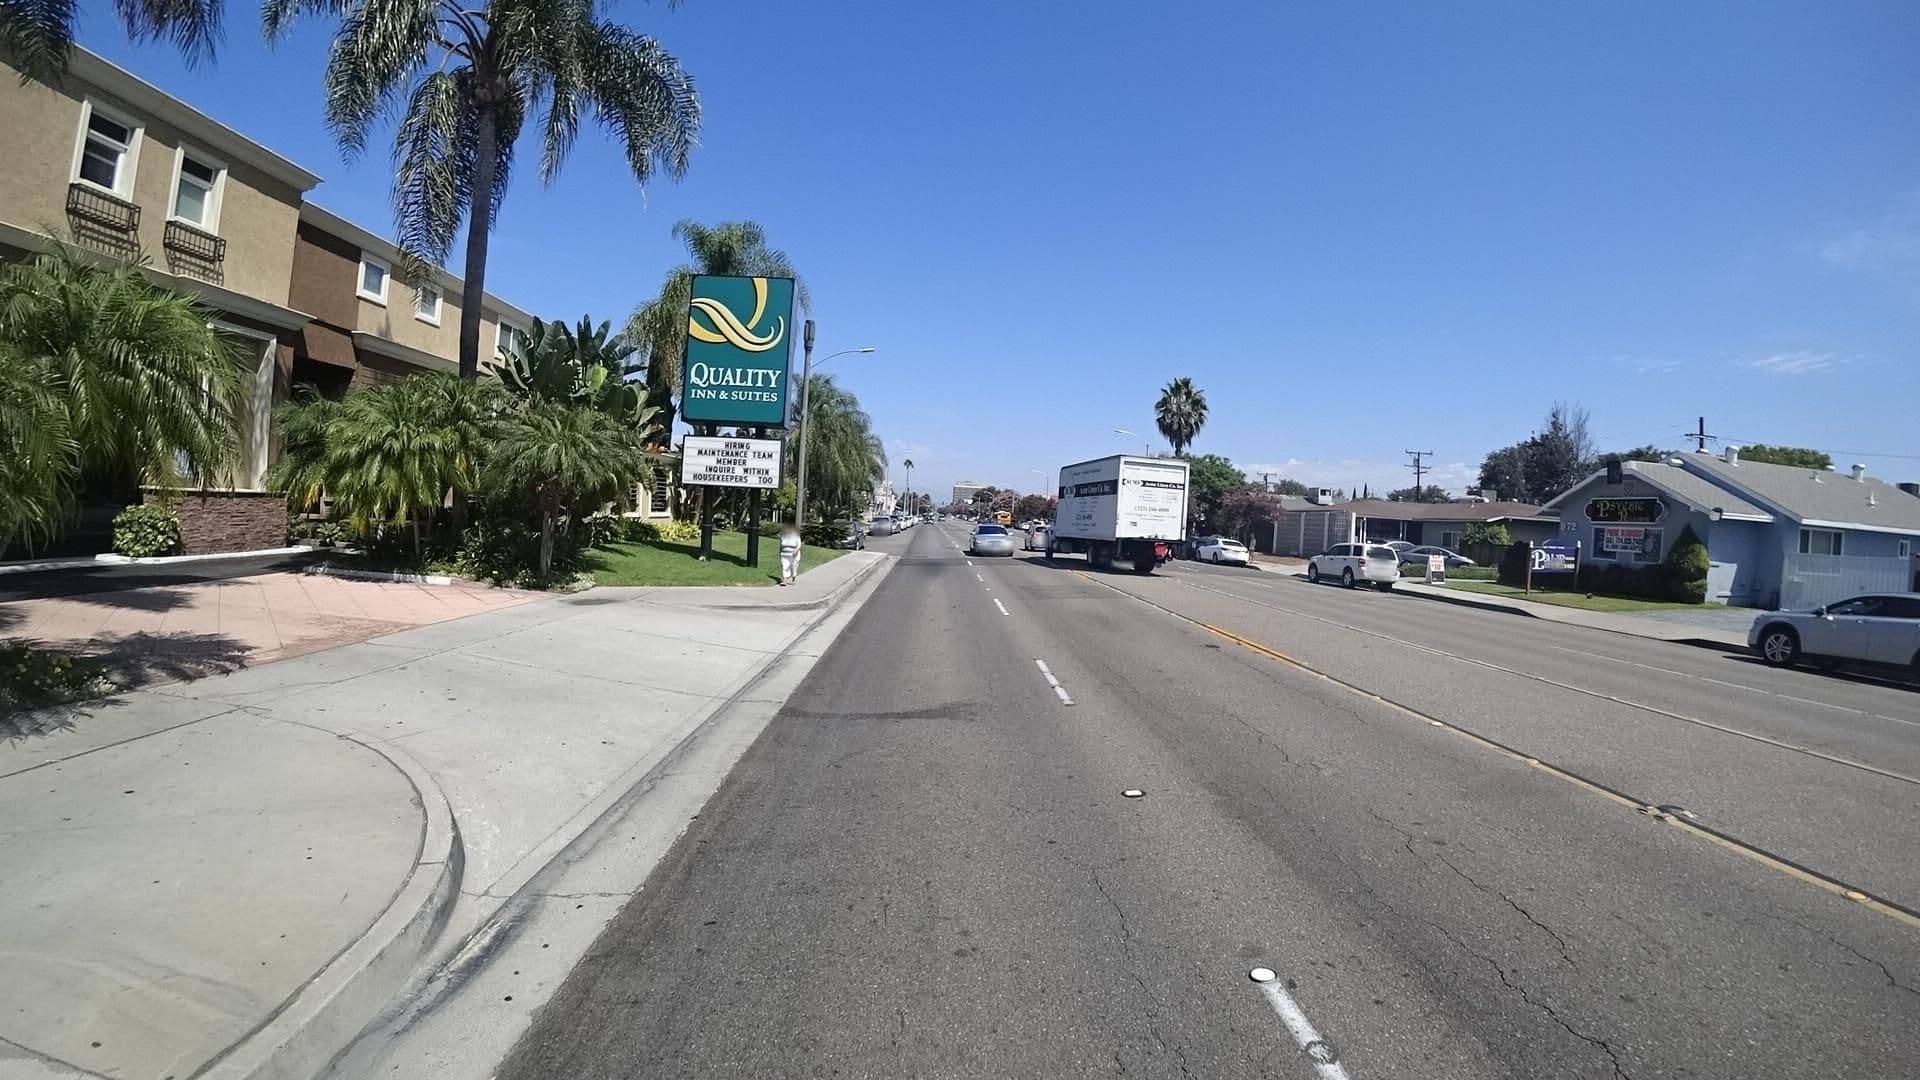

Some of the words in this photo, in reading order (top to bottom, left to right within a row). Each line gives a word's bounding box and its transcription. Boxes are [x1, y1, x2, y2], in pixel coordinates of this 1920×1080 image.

[690, 362, 782, 388] QUALITY
[691, 389, 717, 399] INN
[719, 390, 728, 400] &
[731, 390, 778, 402] SUITES
[724, 442, 751, 450] HIRING
[697, 449, 748, 458] MAINTENANCE
[752, 451, 773, 459] TEAM
[716, 458, 747, 466] MEMBER
[705, 465, 736, 474] INQUIRE
[743, 467, 769, 475] WITHIN
[693, 473, 748, 483] HOUSEKEEPERS
[759, 476, 773, 484] TOO
